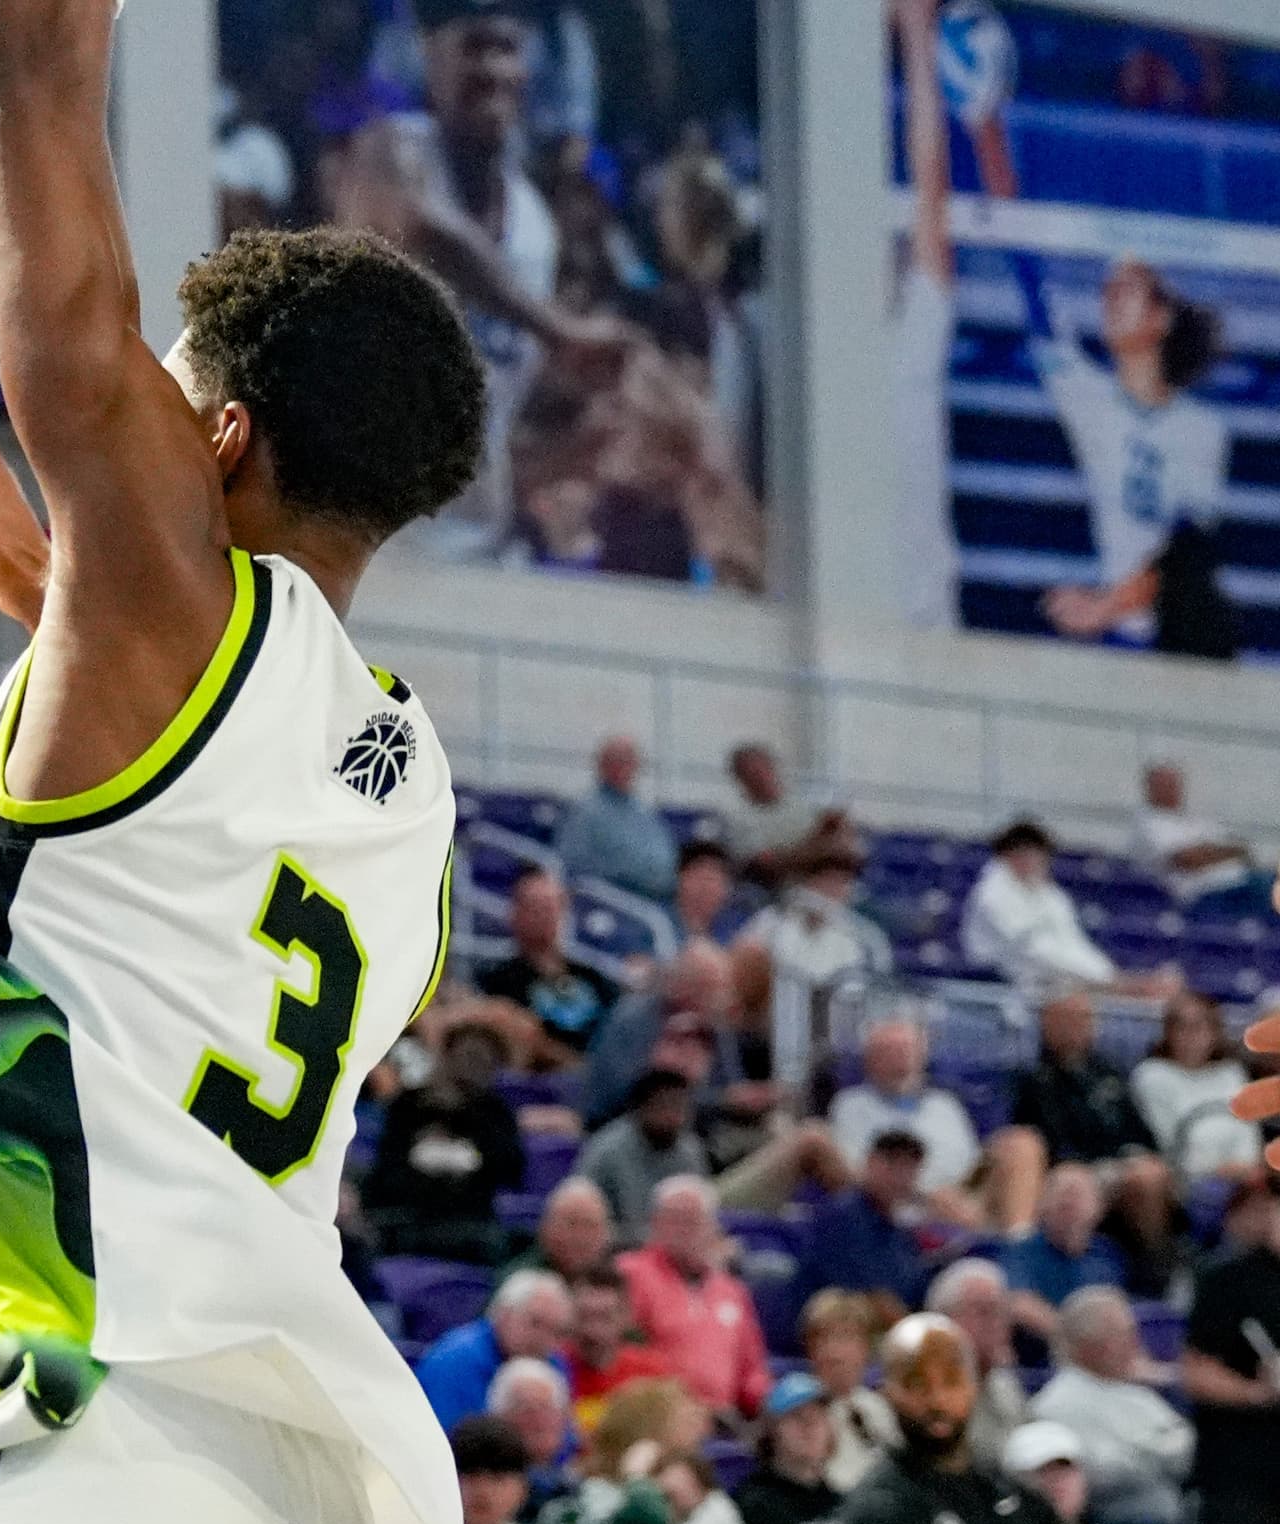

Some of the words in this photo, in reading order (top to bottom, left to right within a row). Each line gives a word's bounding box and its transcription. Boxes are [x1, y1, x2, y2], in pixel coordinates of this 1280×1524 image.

[365, 712, 401, 728] ADIDAS
[400, 720, 417, 760] SELECT
[181, 849, 369, 1188] 3
